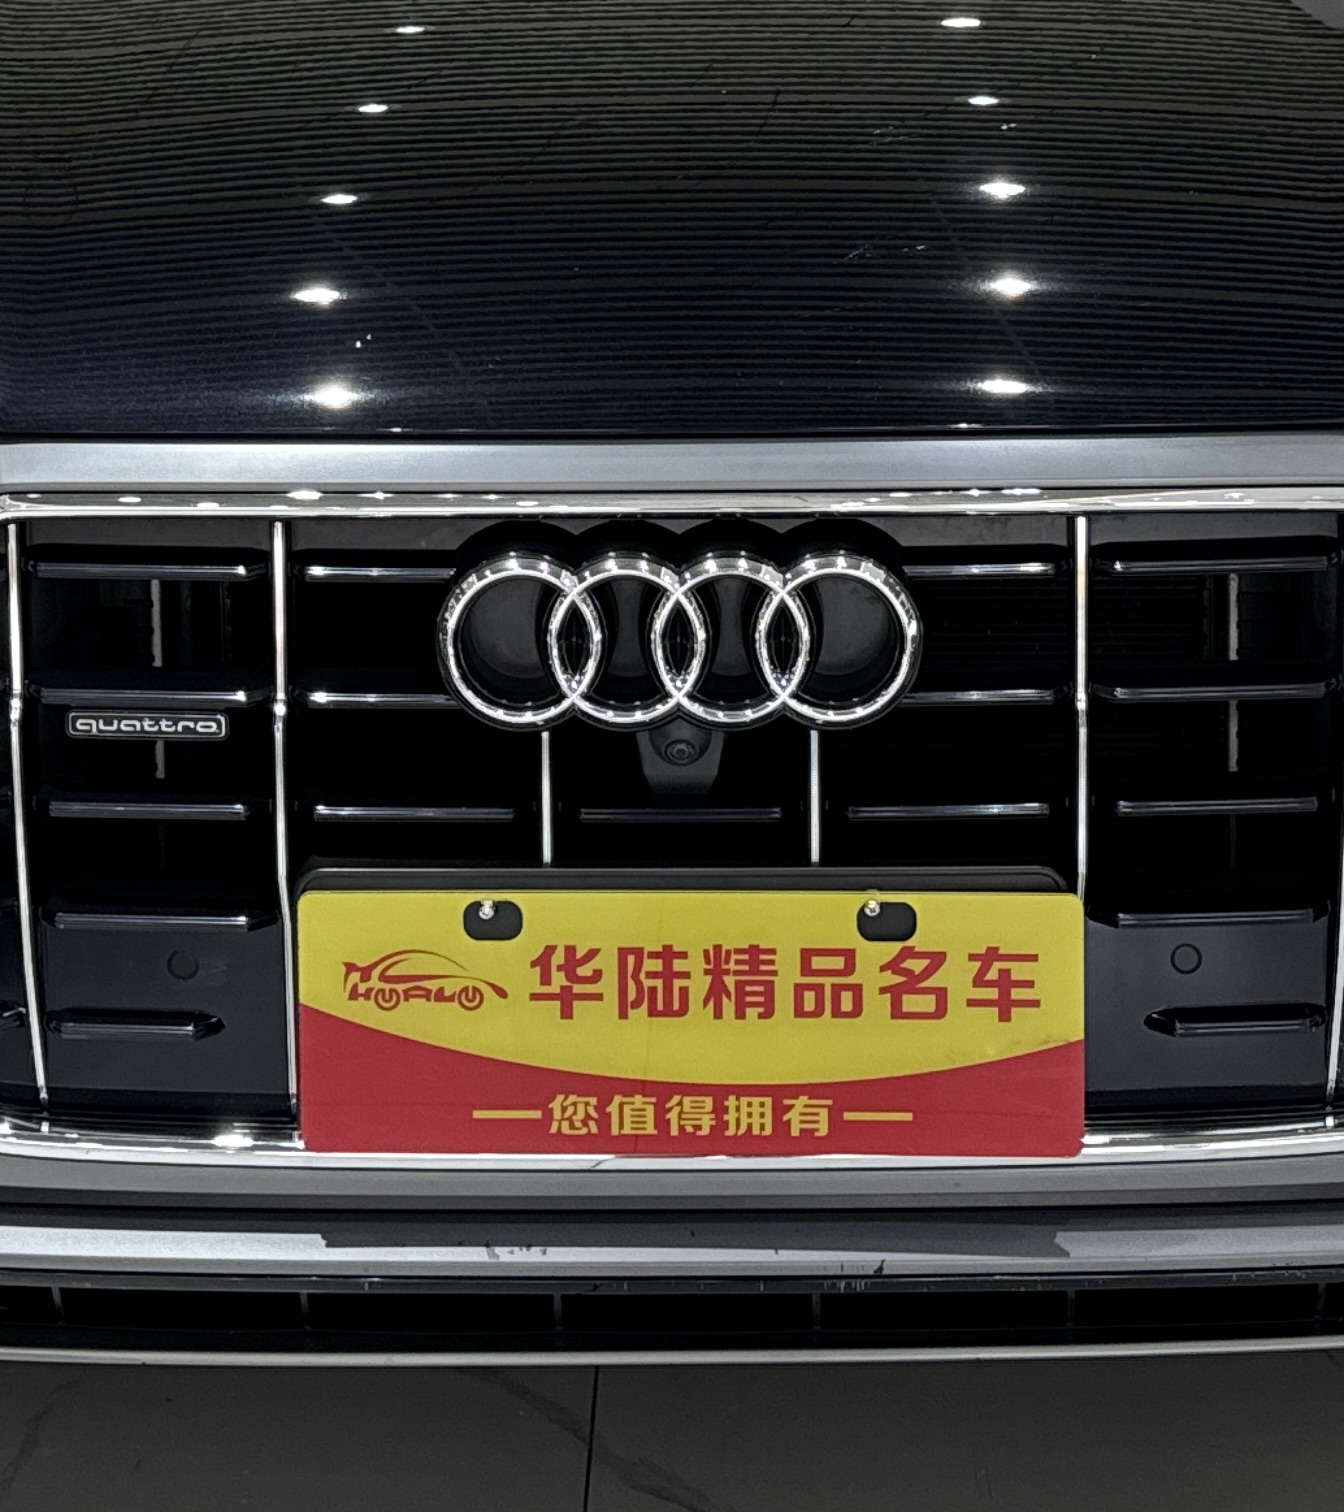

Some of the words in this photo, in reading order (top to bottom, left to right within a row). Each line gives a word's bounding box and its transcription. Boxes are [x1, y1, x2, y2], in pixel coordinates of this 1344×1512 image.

[74, 717, 219, 734] quattro
[527, 943, 1042, 1023] 华陆精品名车
[547, 1093, 834, 1137] 您值得拥有
